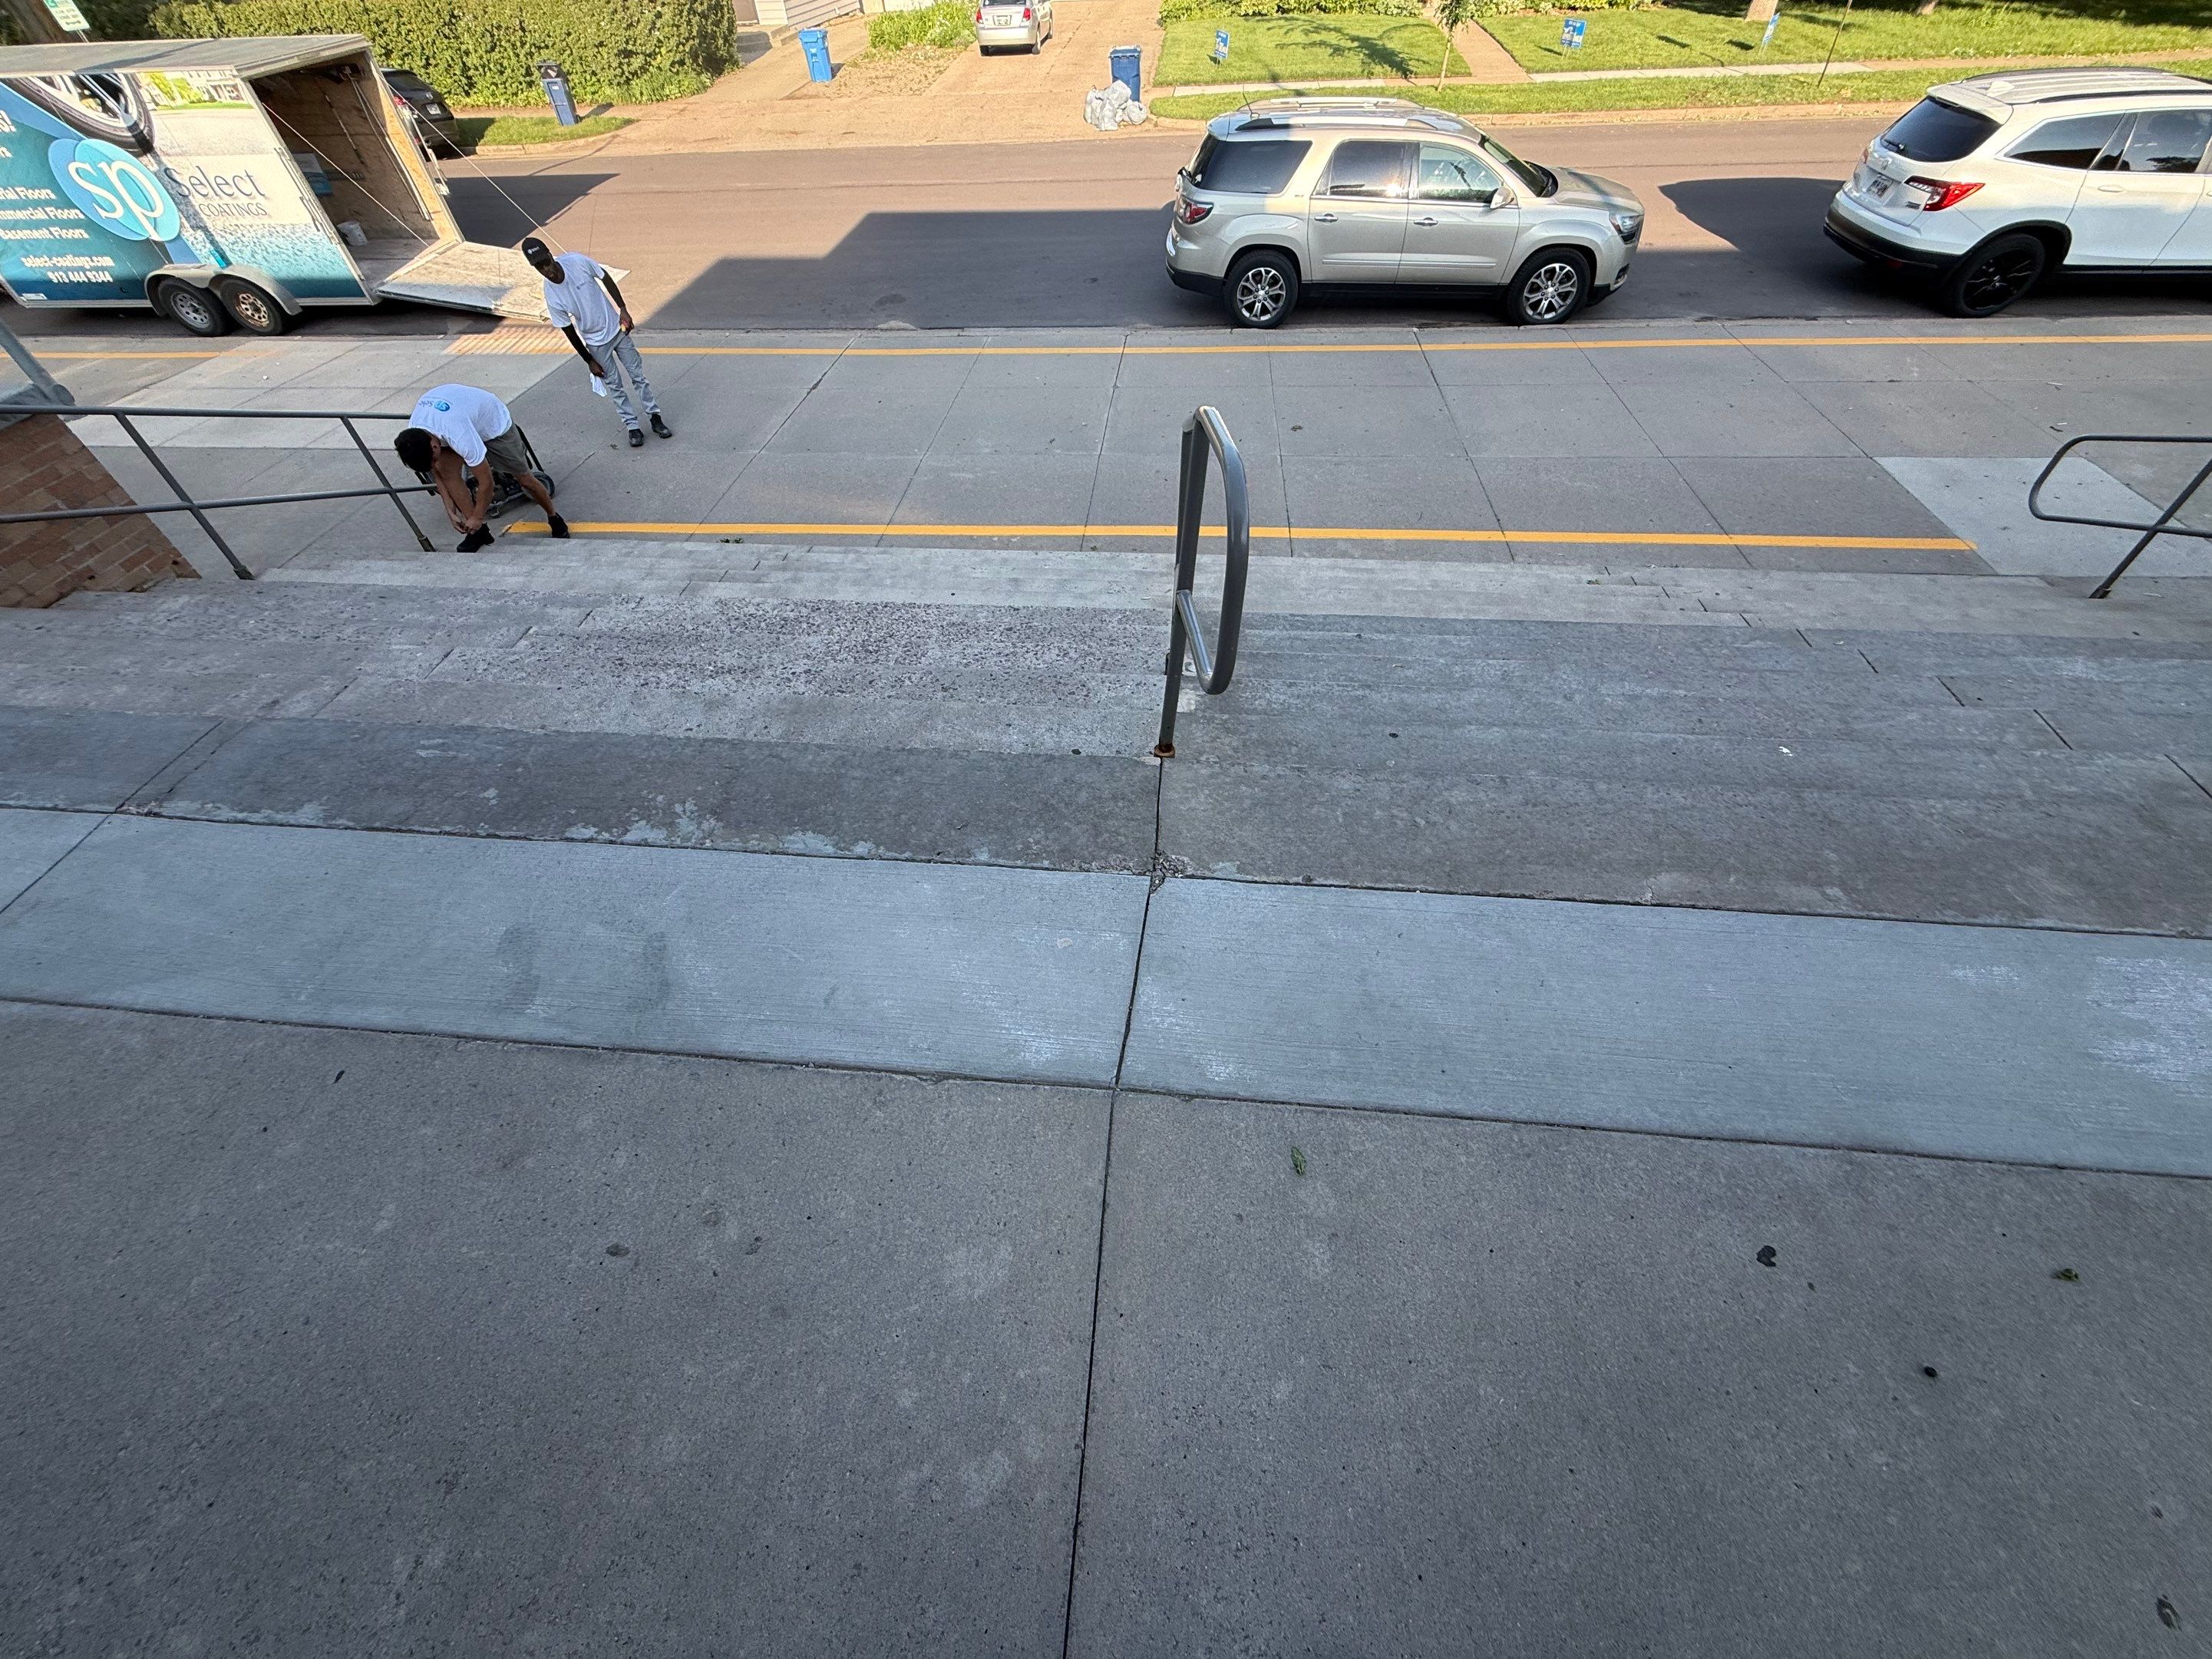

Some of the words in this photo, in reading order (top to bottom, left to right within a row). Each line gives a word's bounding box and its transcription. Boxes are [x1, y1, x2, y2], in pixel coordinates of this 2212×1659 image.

[163, 165, 266, 197] Select
[14, 186, 56, 200] Floors
[45, 206, 86, 220] Floors
[198, 202, 268, 217] COATINGS
[48, 226, 90, 240] Floors
[20, 254, 115, 269] select-coatings.com
[47, 271, 70, 283] 913
[68, 271, 89, 283] 444
[84, 271, 114, 283] 9344
